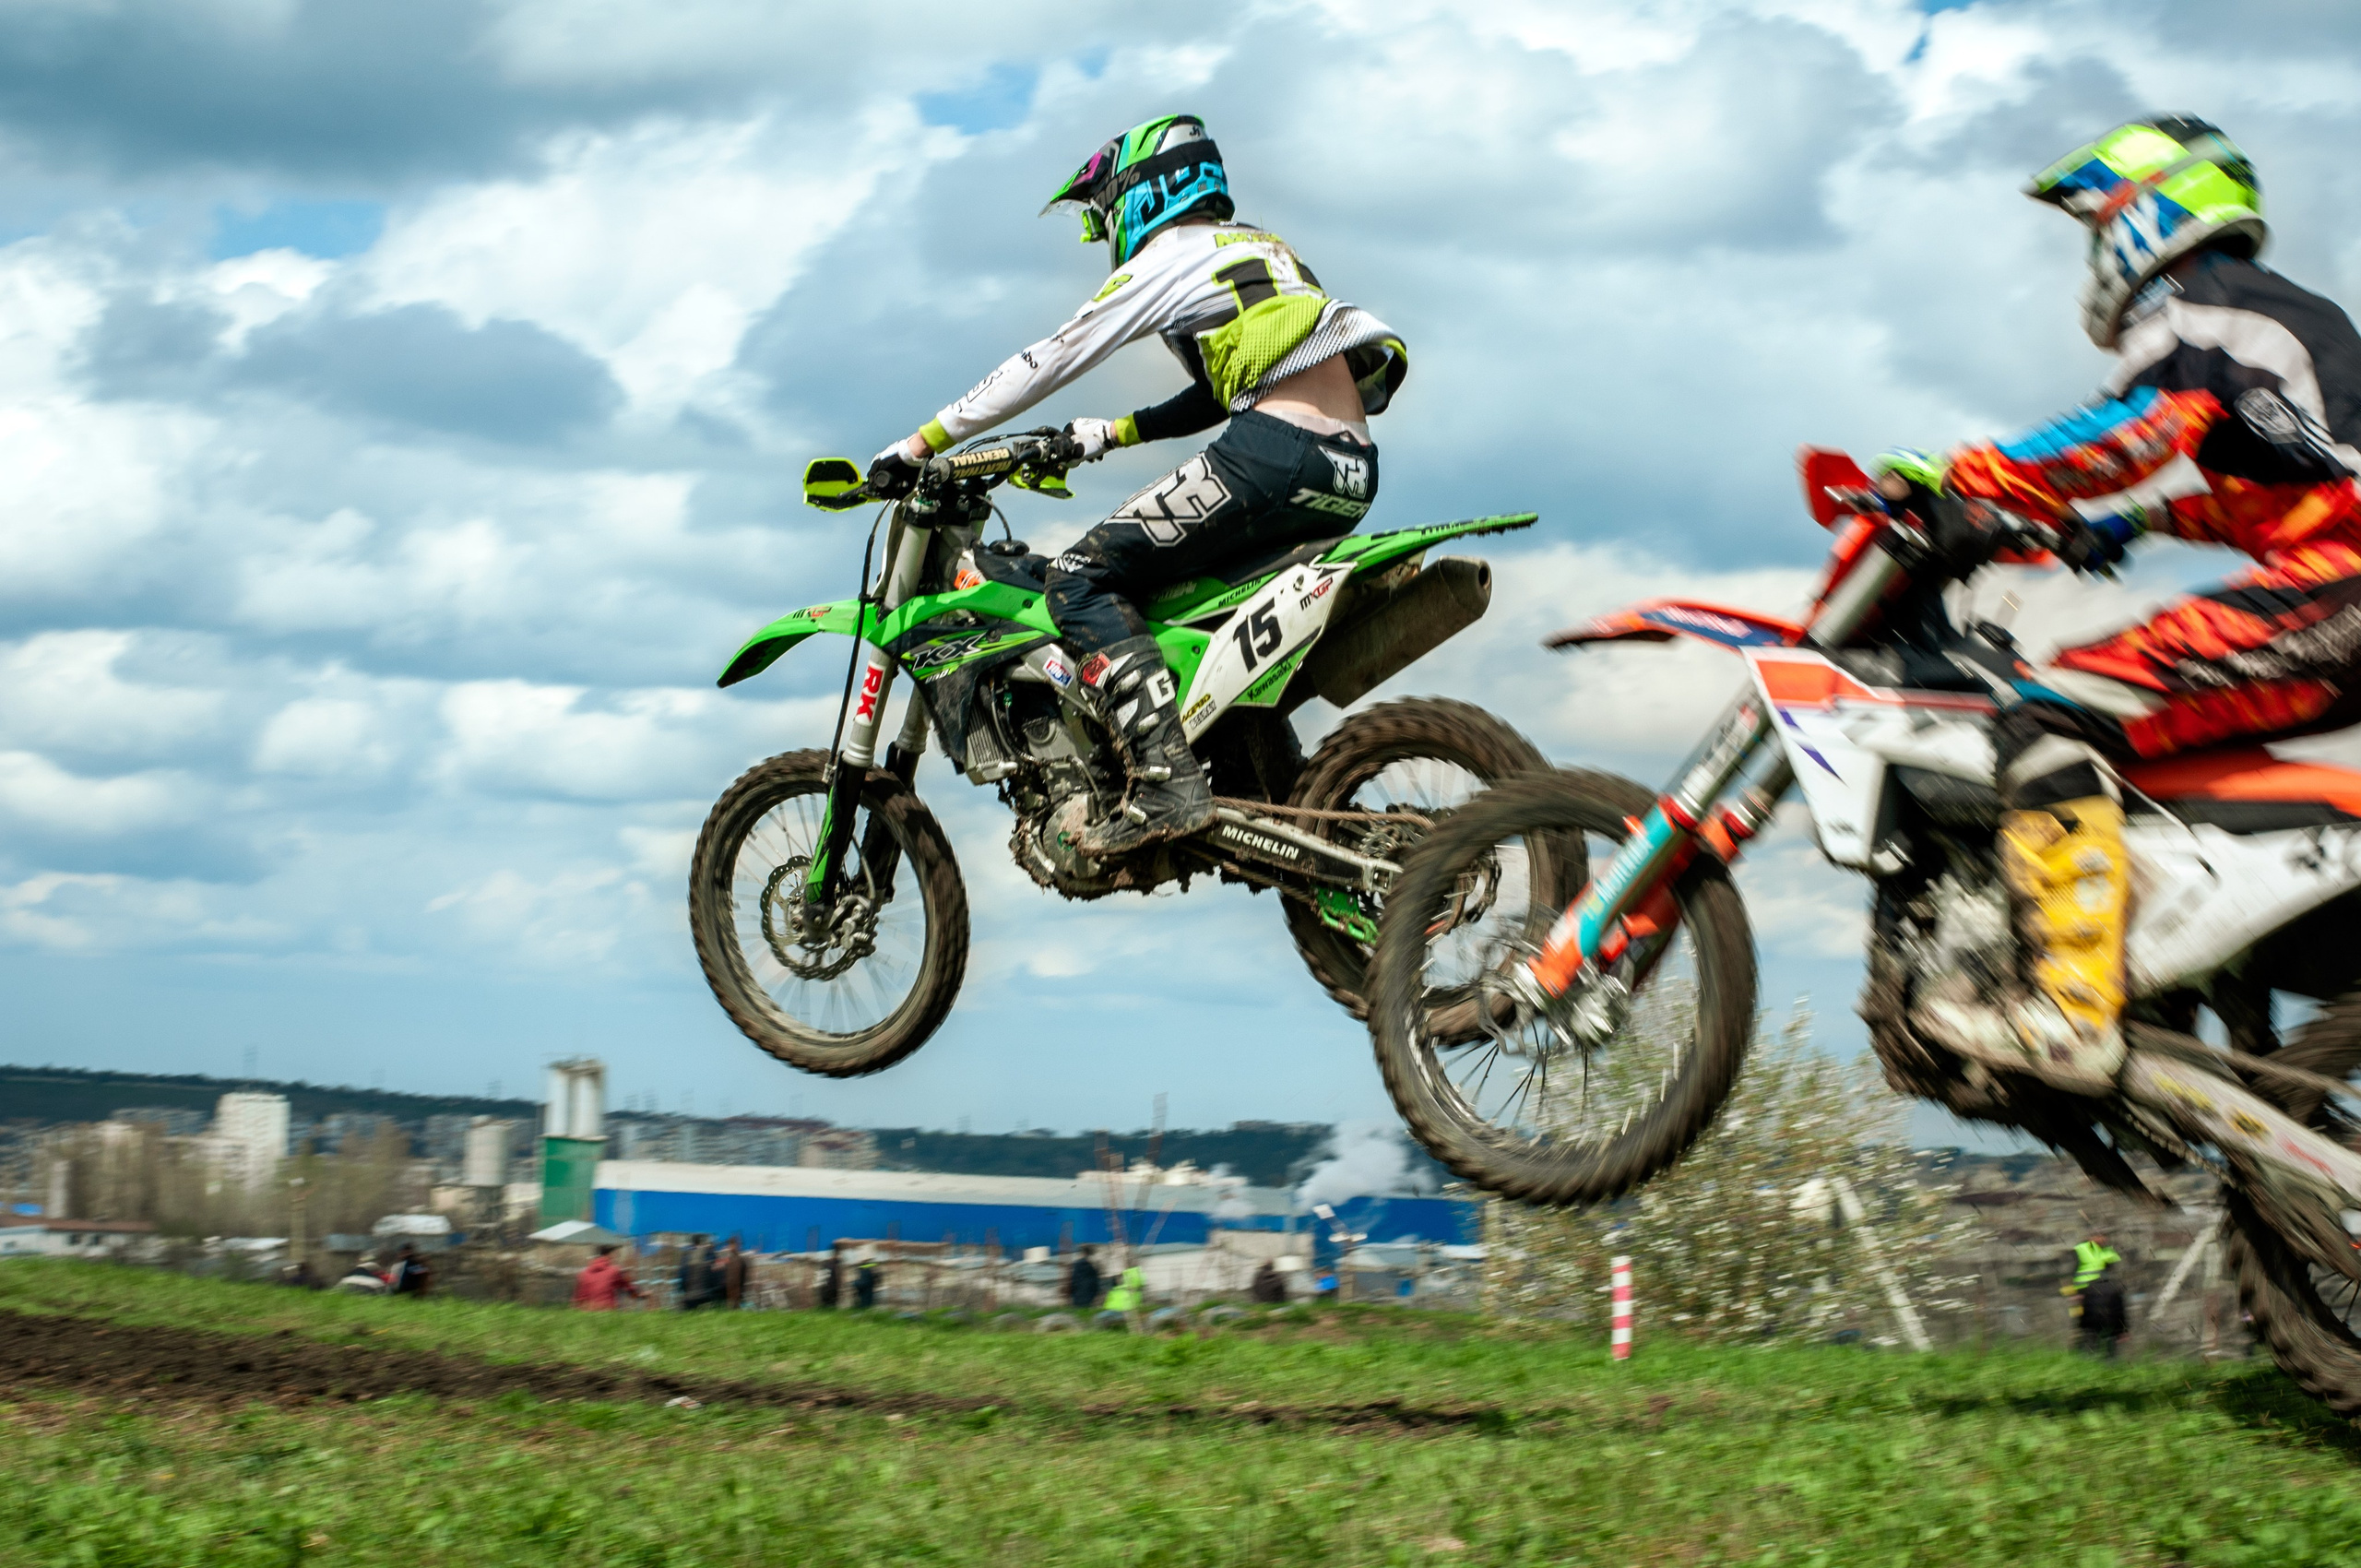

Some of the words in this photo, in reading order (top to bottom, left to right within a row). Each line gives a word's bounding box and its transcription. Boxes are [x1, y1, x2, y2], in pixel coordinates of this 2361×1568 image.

[1095, 163, 1141, 210] 00%
[948, 447, 1010, 467] RENTHAL
[1217, 577, 1262, 608] MICHELIN
[1232, 596, 1283, 674] 15
[857, 665, 884, 722] RK
[1247, 659, 1292, 700] Kawasaki
[1222, 825, 1299, 860] MICHELIN
